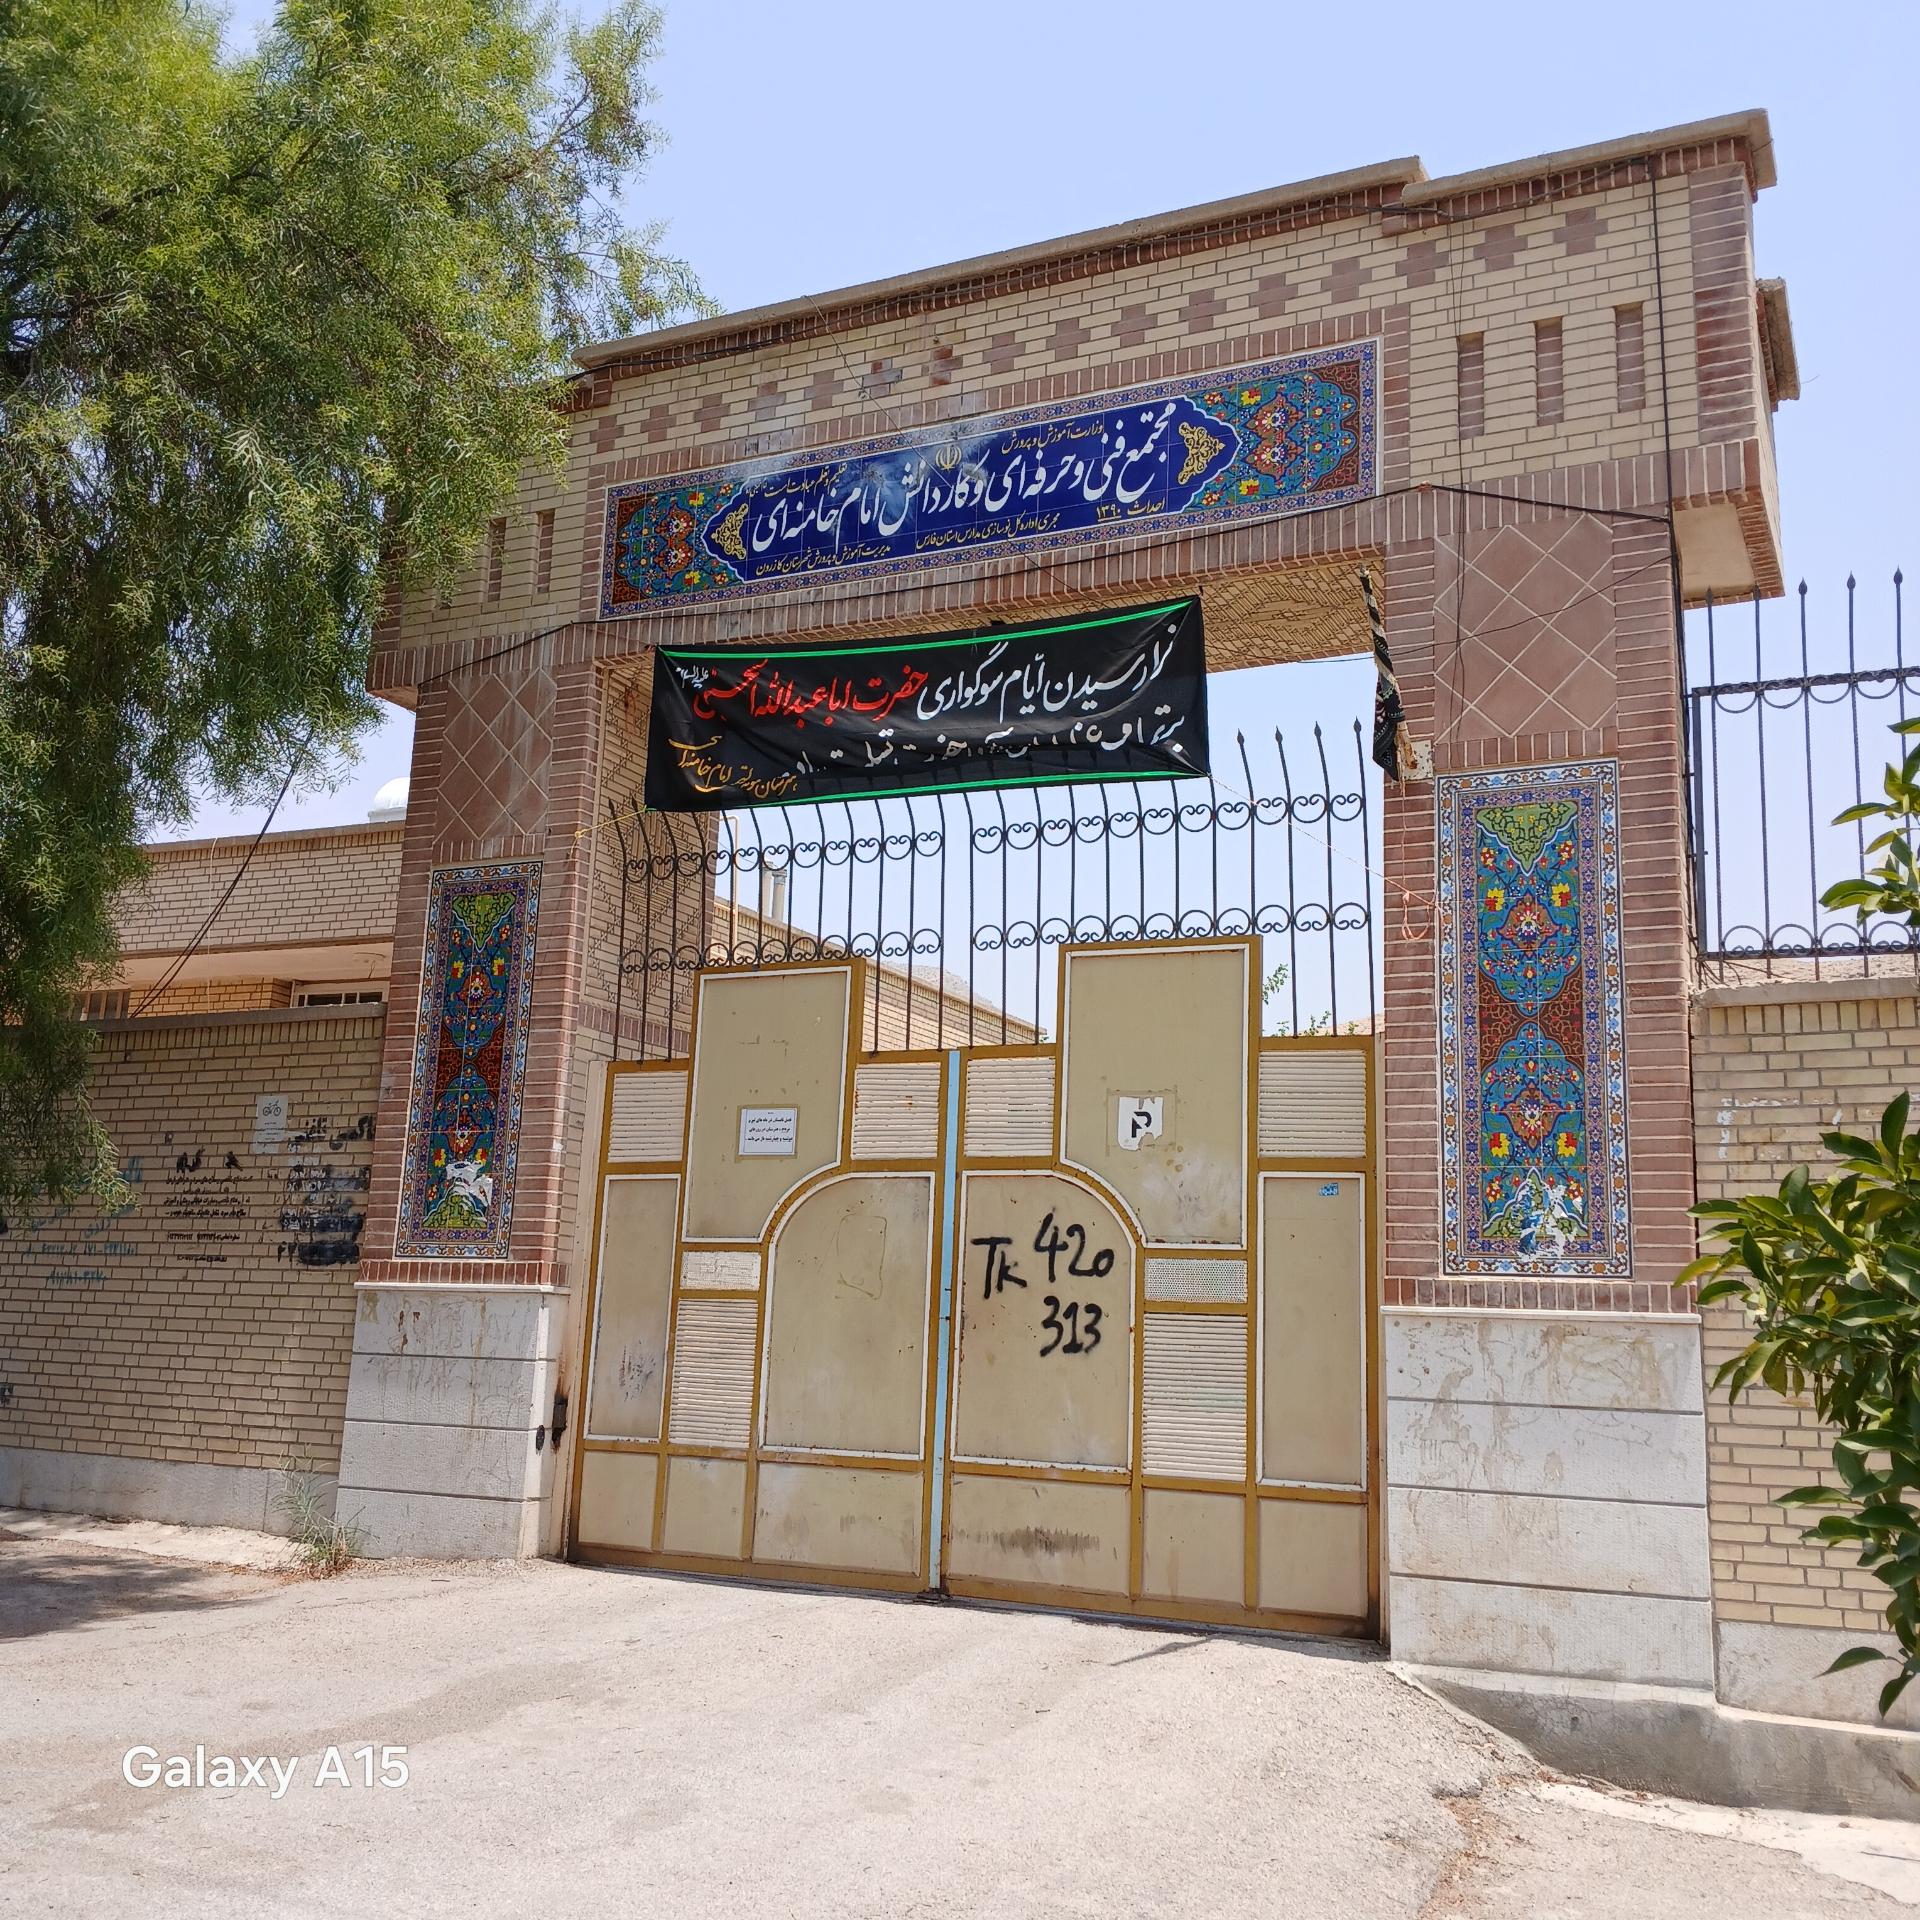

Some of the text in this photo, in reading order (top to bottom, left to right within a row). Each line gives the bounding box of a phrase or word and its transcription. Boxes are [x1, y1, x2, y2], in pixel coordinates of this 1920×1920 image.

[1038, 421, 1075, 448] آموزش
[1071, 420, 1104, 440] وزارت
[1002, 430, 1032, 454] پرورش
[1116, 402, 1177, 504] مجتمع
[1083, 419, 1126, 502] فنی
[764, 477, 791, 498] است
[787, 479, 815, 494] عبادت
[1096, 497, 1165, 518] احداث ۱۳۹۰
[835, 486, 881, 554] امام
[1038, 512, 1061, 531] مجری
[916, 533, 936, 549] فارس
[935, 530, 958, 547] استان
[958, 526, 981, 543] مدارس
[835, 544, 862, 566] آموزش
[862, 546, 891, 560] مدیریت
[755, 555, 786, 576] کازرون
[916, 641, 1009, 721] سوگواری
[852, 665, 929, 722] حضرت
[706, 763, 733, 789] امام
[1033, 1211, 1115, 1283] 420
[1040, 1295, 1103, 1357] 313
